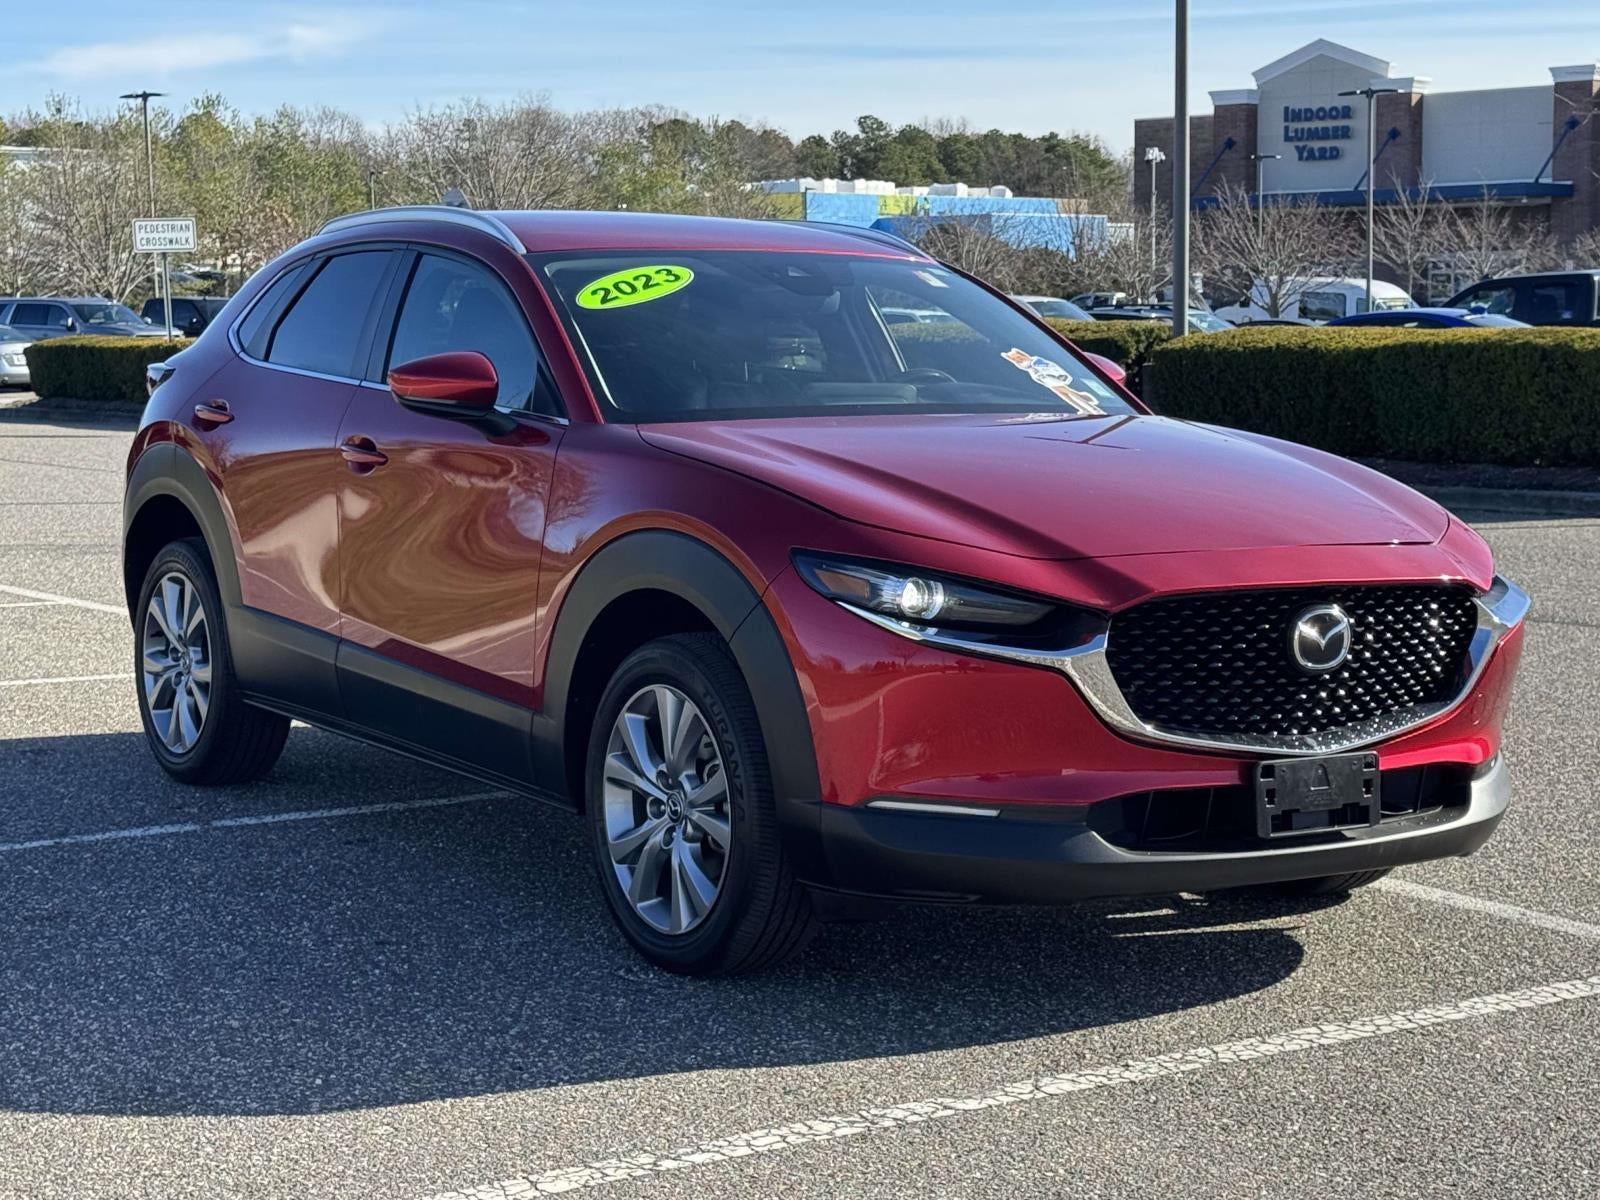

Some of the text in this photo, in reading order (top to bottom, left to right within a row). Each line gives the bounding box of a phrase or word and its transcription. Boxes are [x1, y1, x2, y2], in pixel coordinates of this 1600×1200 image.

[1283, 105, 1352, 123] INDOOR
[1283, 125, 1351, 142] LUMBER
[1294, 144, 1340, 161] YARD
[138, 223, 191, 234] PEDESTRIAN
[139, 236, 190, 247] CROSSWALK
[590, 268, 681, 305] 2023
[702, 687, 746, 823] TURANZA
